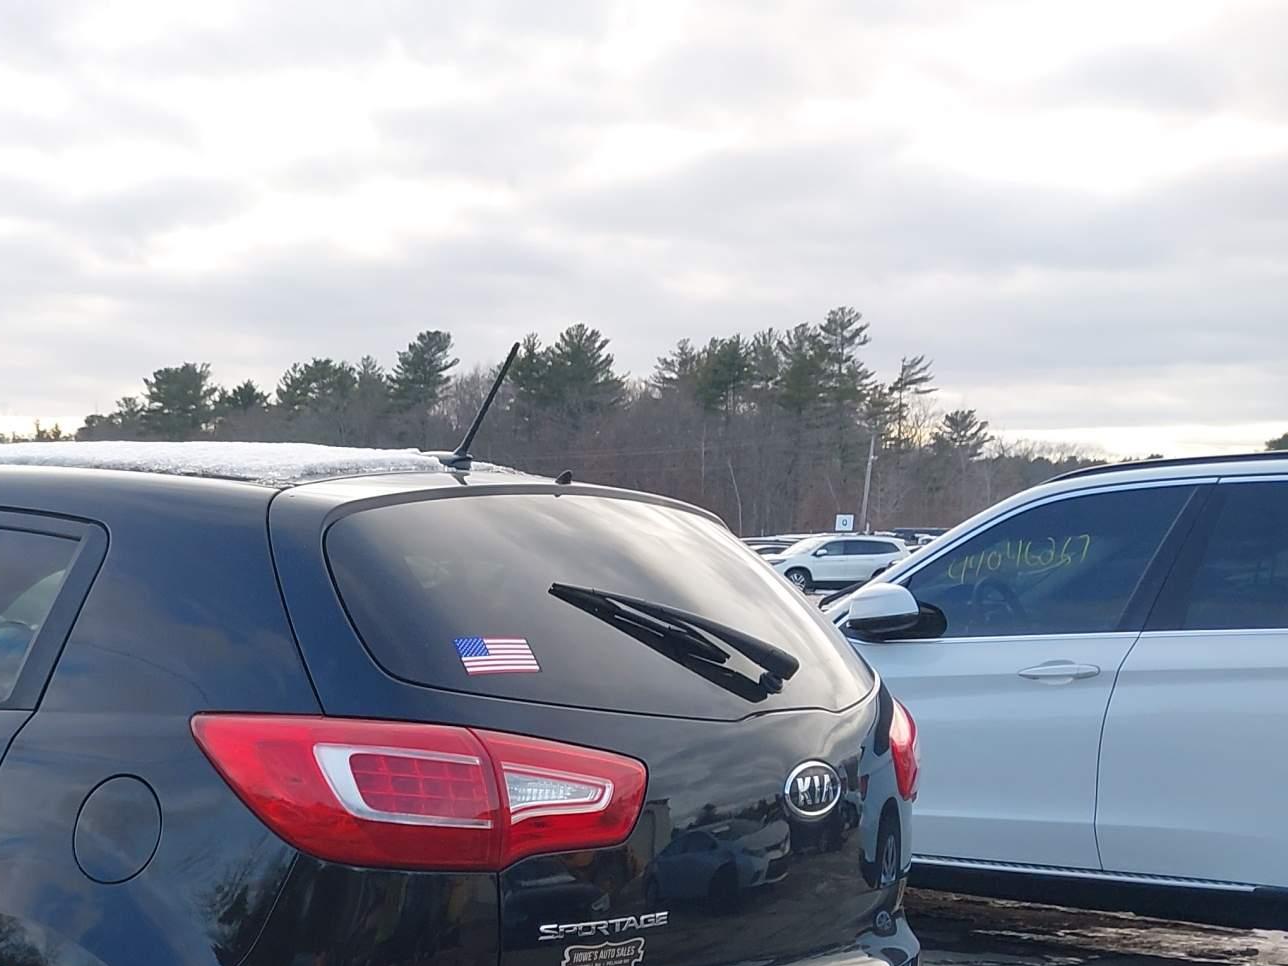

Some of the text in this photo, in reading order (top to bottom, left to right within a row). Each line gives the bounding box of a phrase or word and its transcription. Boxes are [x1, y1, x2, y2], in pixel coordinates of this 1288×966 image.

[796, 774, 834, 806] KIA
[538, 911, 669, 940] SPORTAGE
[599, 947, 616, 960] AUTO
[616, 945, 636, 957] SALES
